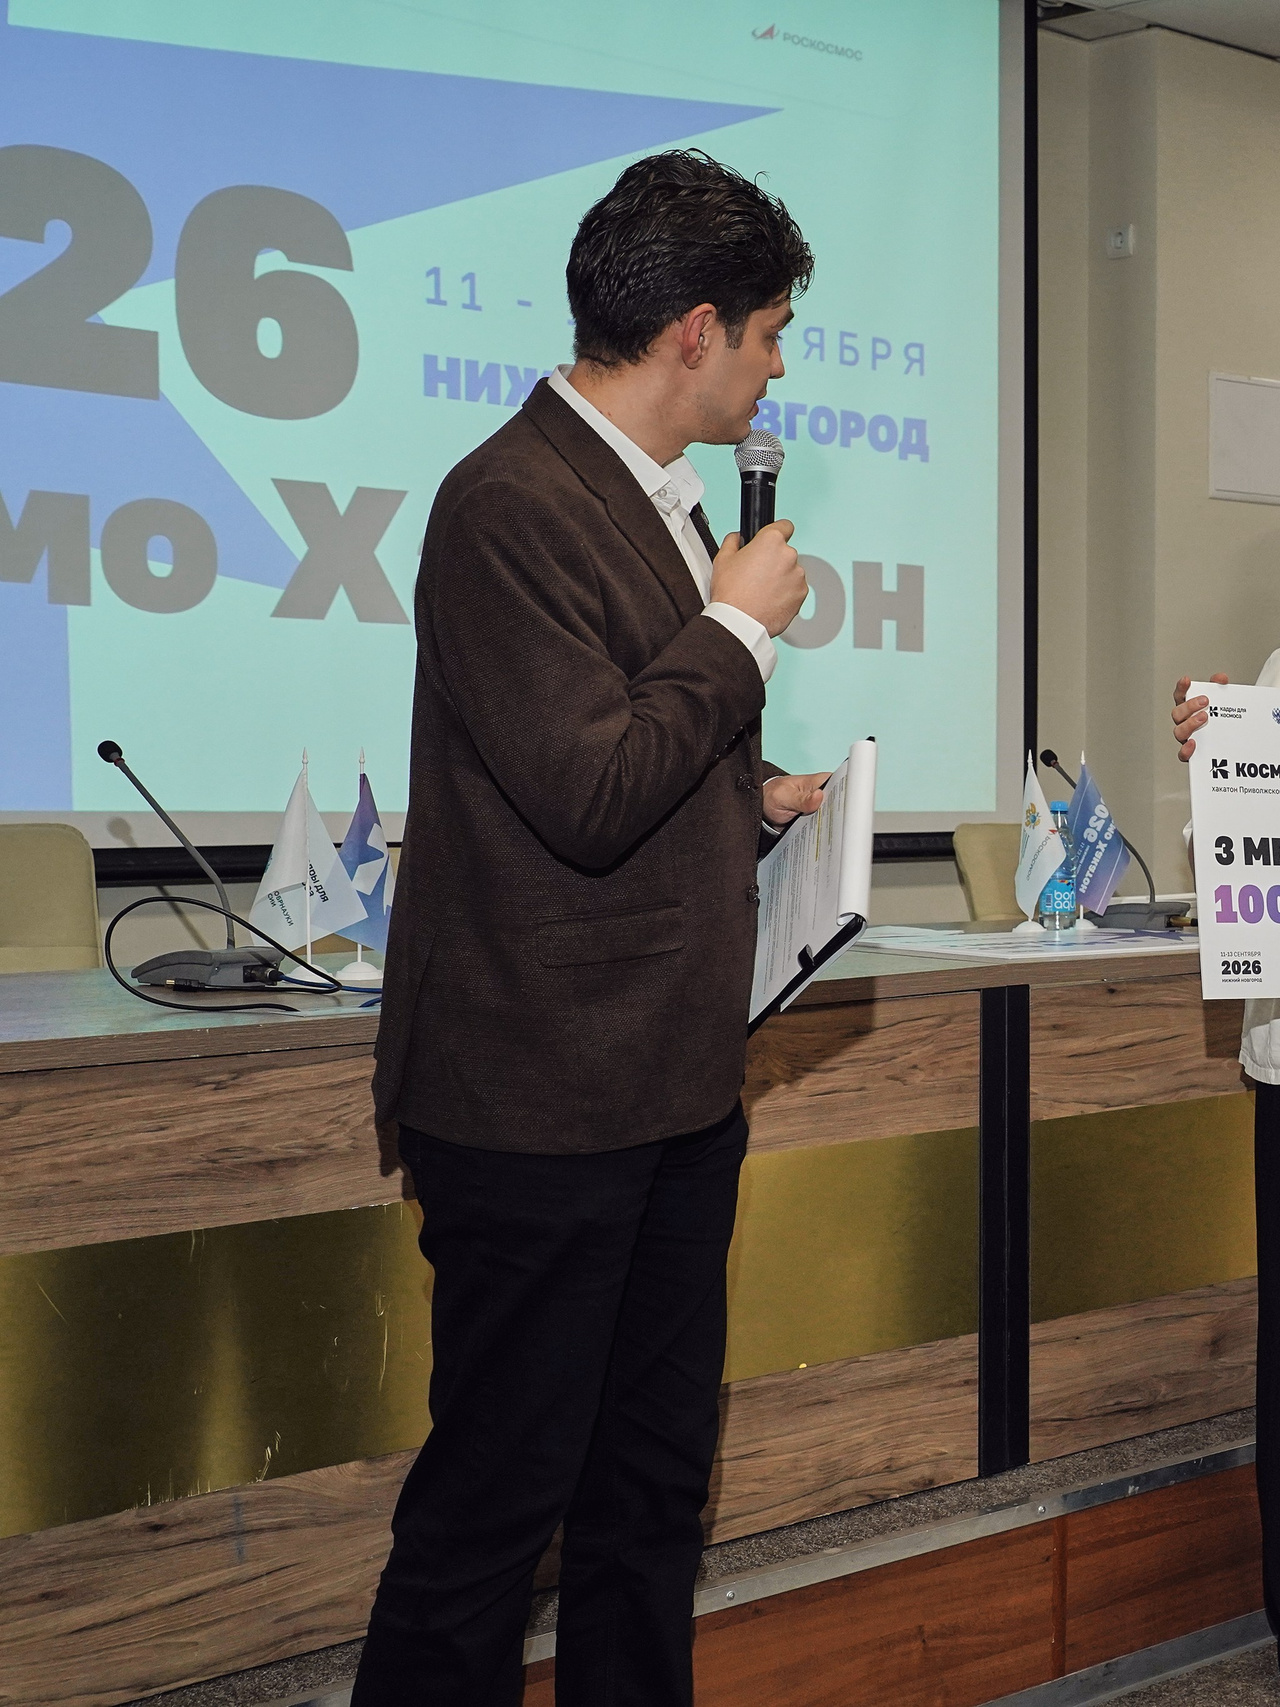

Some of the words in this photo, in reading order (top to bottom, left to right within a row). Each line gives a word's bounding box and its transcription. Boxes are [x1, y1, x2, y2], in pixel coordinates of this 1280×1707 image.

[783, 32, 862, 61] РОСКОСМОС
[424, 266, 482, 311] 11
[751, 399, 930, 463] ВГОРОД
[1214, 836, 1235, 866] 3
[273, 890, 294, 927] ОБРНАУКИ
[1221, 960, 1262, 975] 2026
